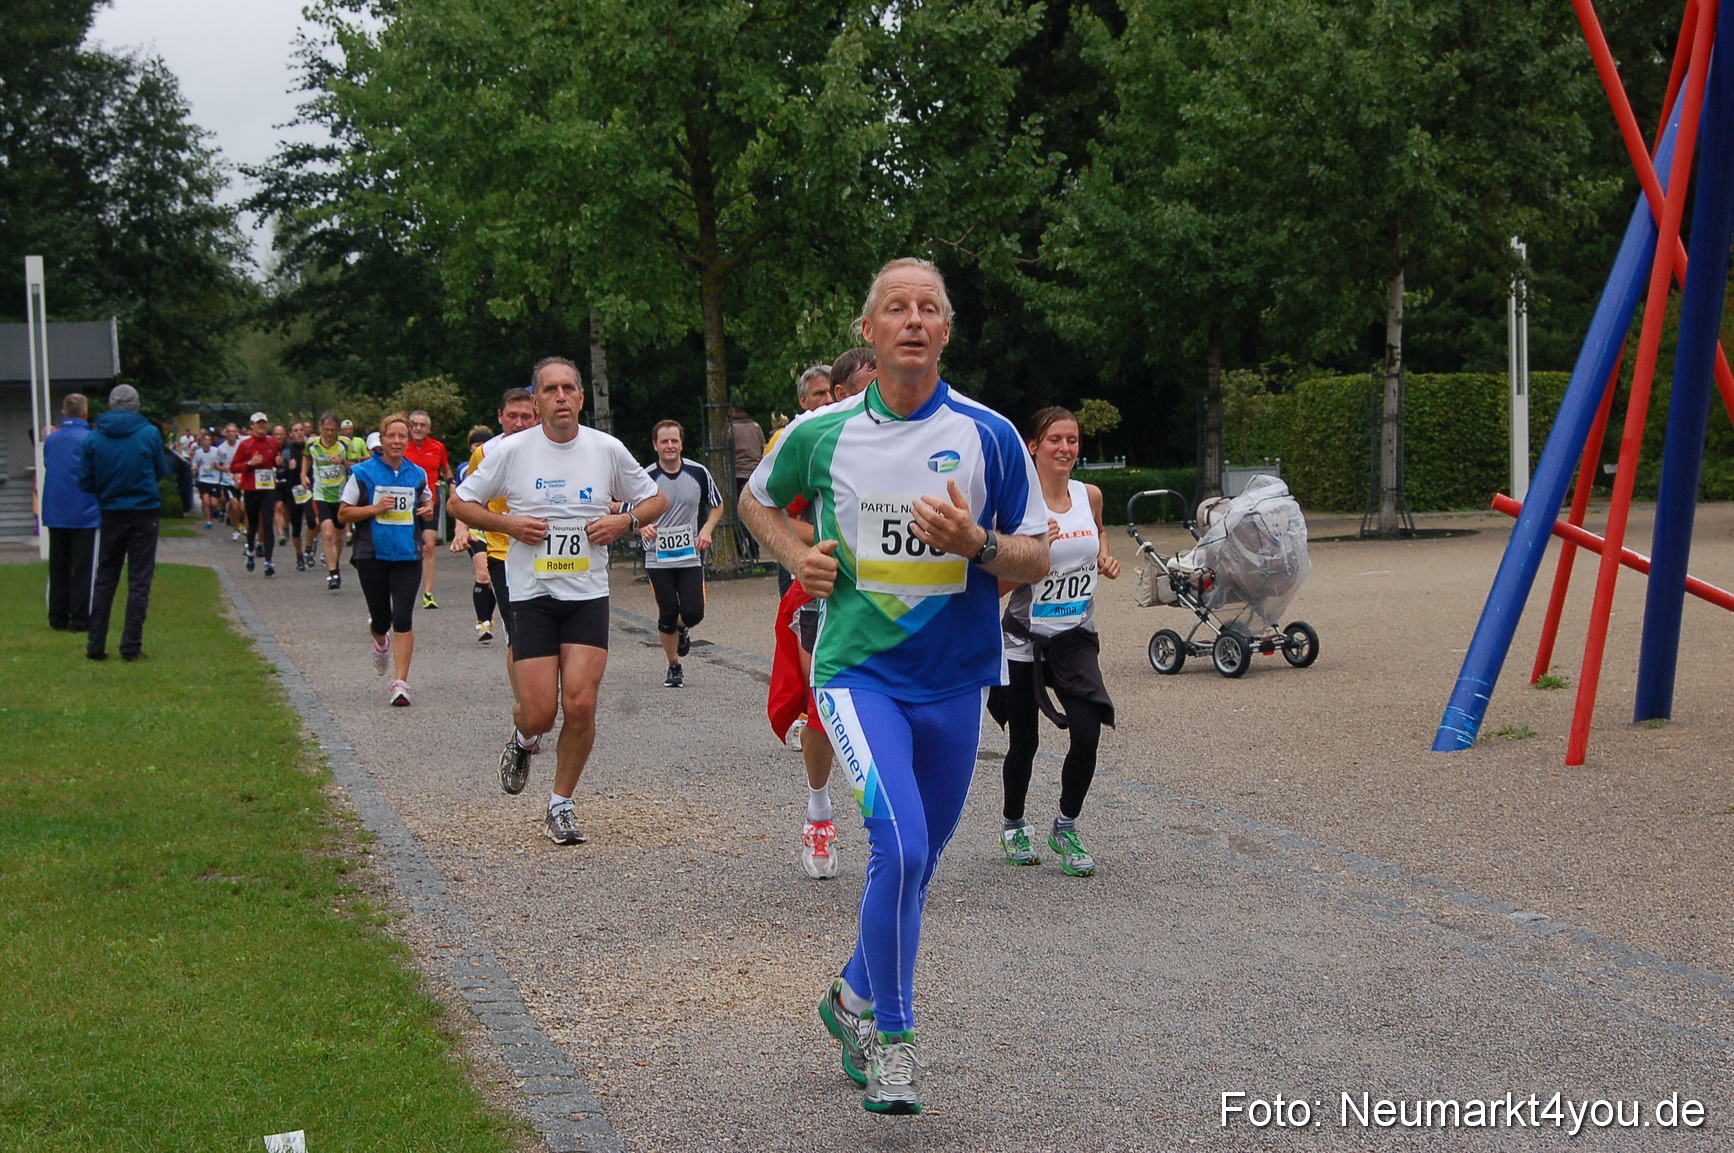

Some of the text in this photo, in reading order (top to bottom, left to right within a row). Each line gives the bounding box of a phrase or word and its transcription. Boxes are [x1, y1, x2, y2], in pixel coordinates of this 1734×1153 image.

[860, 502, 898, 514] PARTL
[543, 533, 581, 556] 178
[659, 533, 691, 550] 3023
[881, 518, 947, 557] 58
[546, 561, 575, 570] Robert
[1040, 574, 1092, 602] 2702
[1054, 606, 1077, 615] Anna
